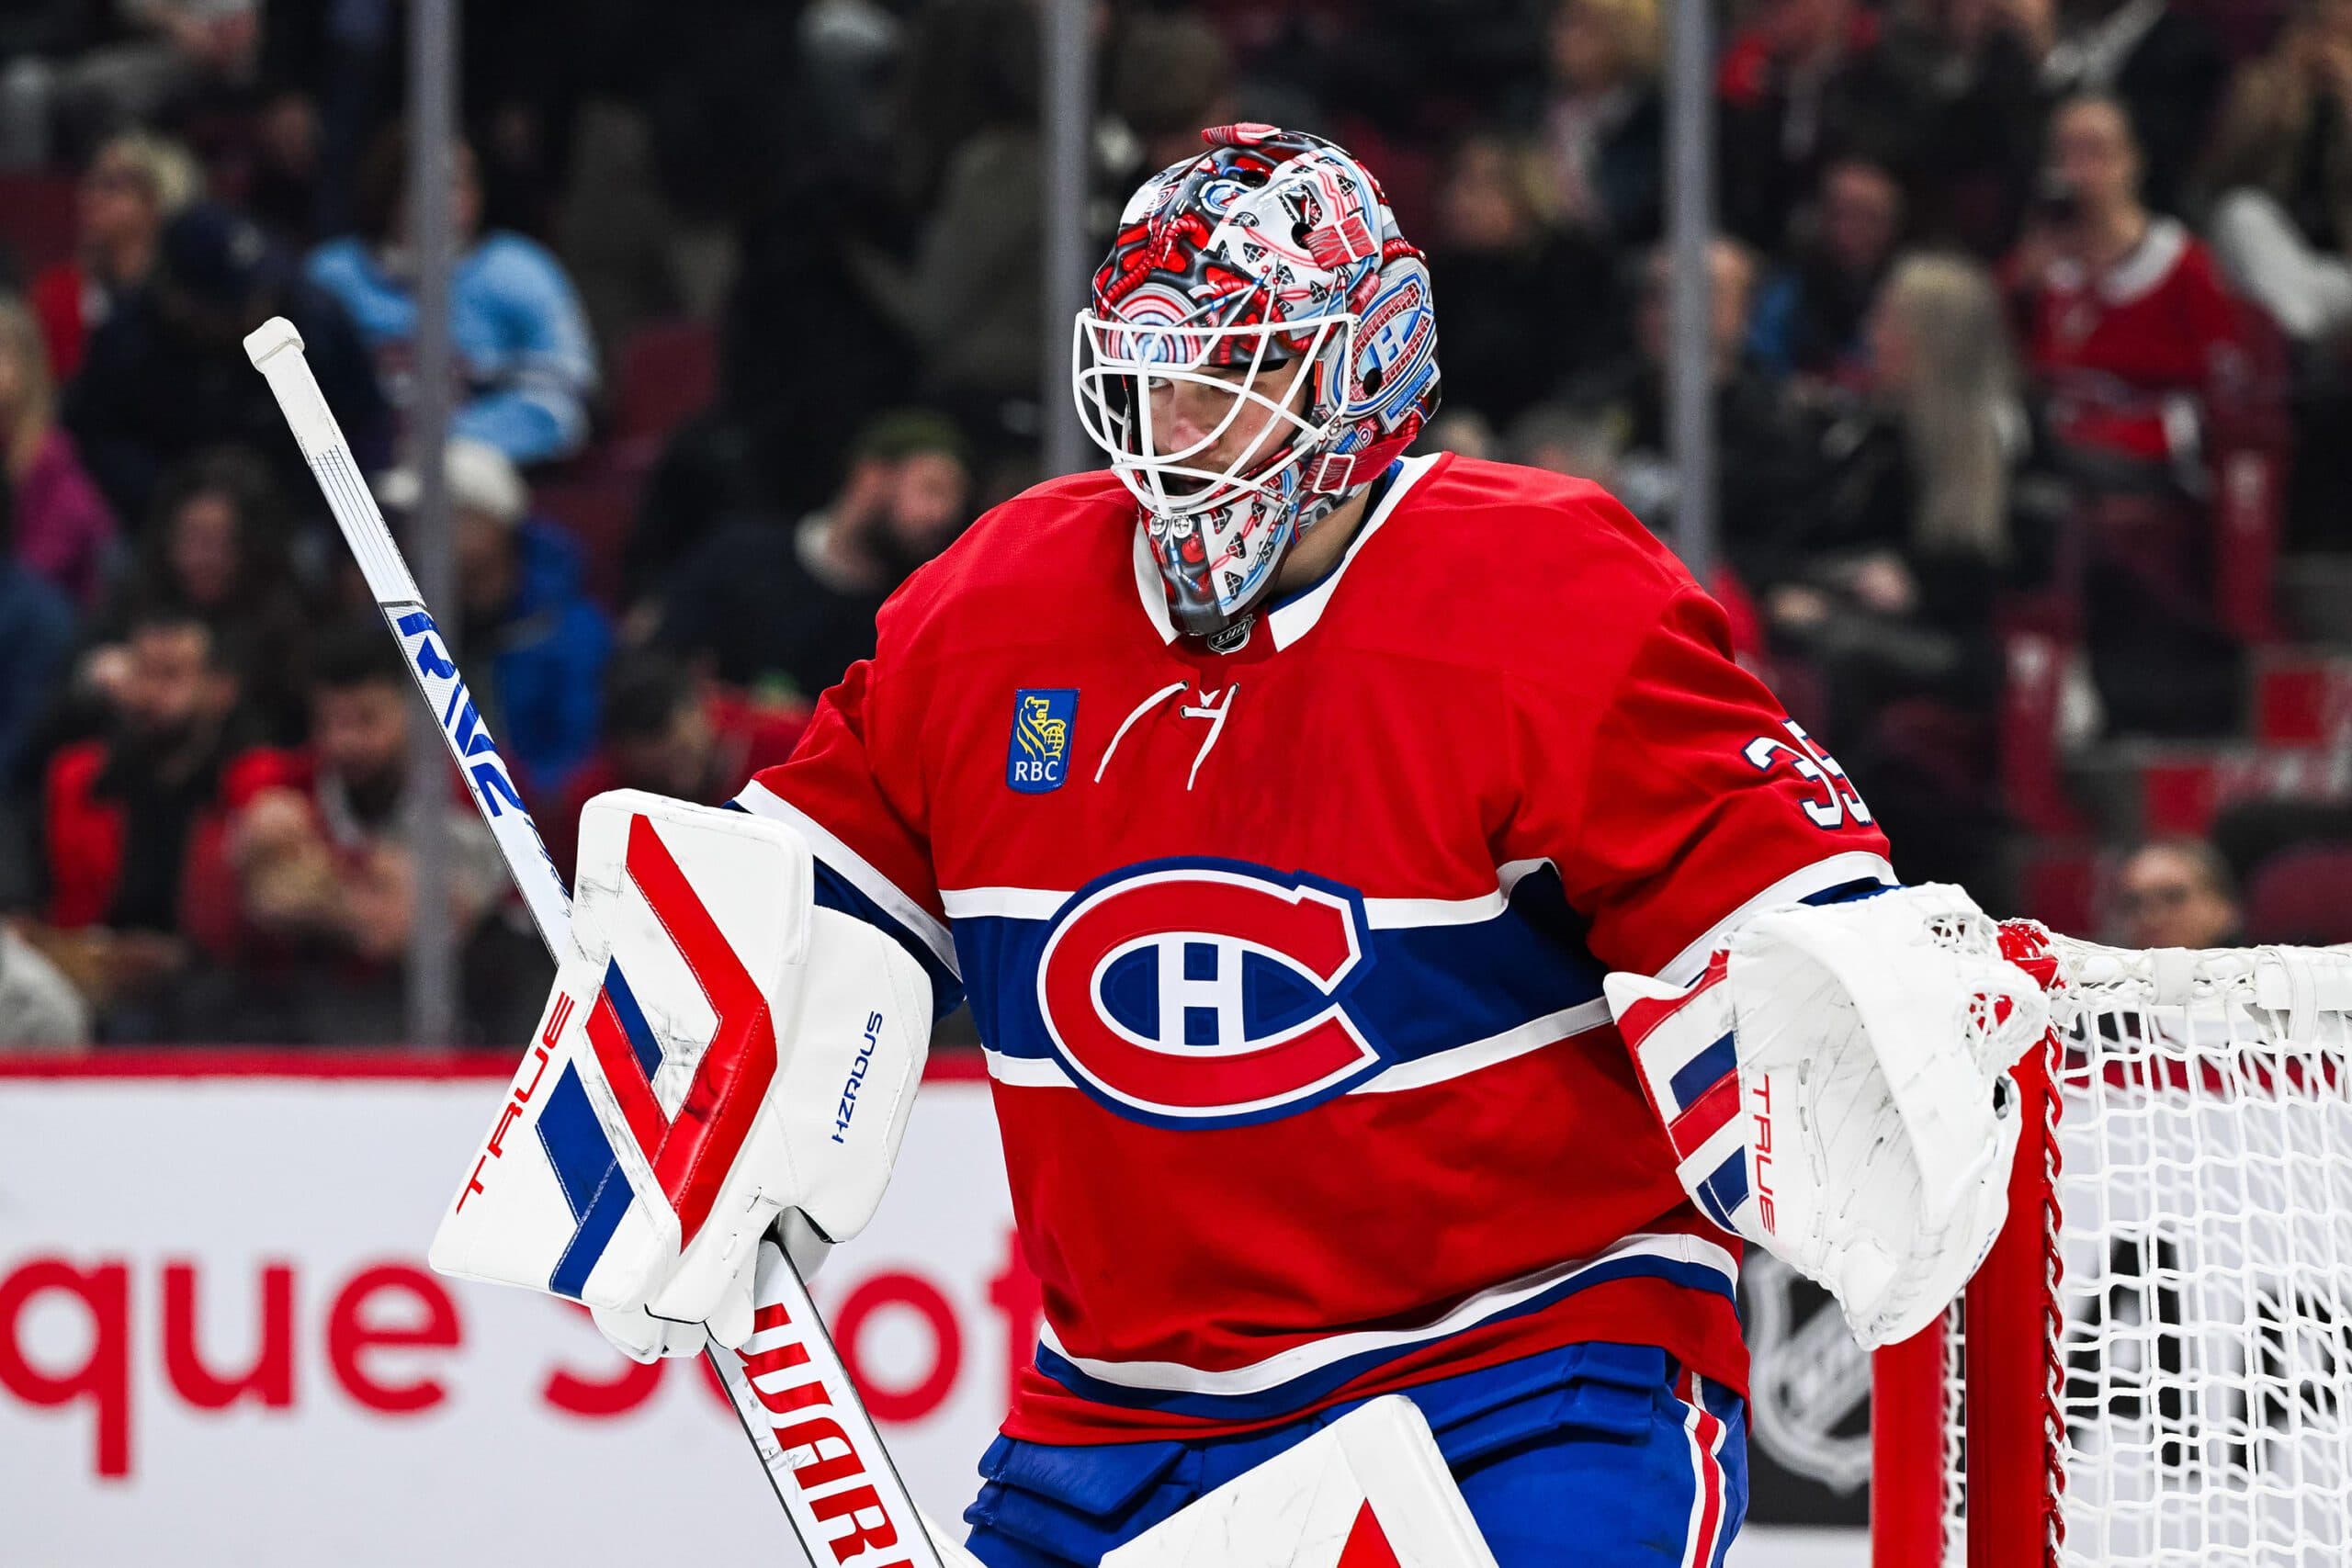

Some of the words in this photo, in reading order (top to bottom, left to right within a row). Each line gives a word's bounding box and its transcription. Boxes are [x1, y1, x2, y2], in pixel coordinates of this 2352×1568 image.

[1014, 761, 1058, 781] RBC
[1742, 717, 1873, 829] 35
[457, 991, 575, 1214] TRUE
[831, 1010, 883, 1144] HZRDUS
[1752, 1073, 1776, 1236] TRUE
[0, 1255, 462, 1478] que
[735, 1302, 915, 1568] WAR
